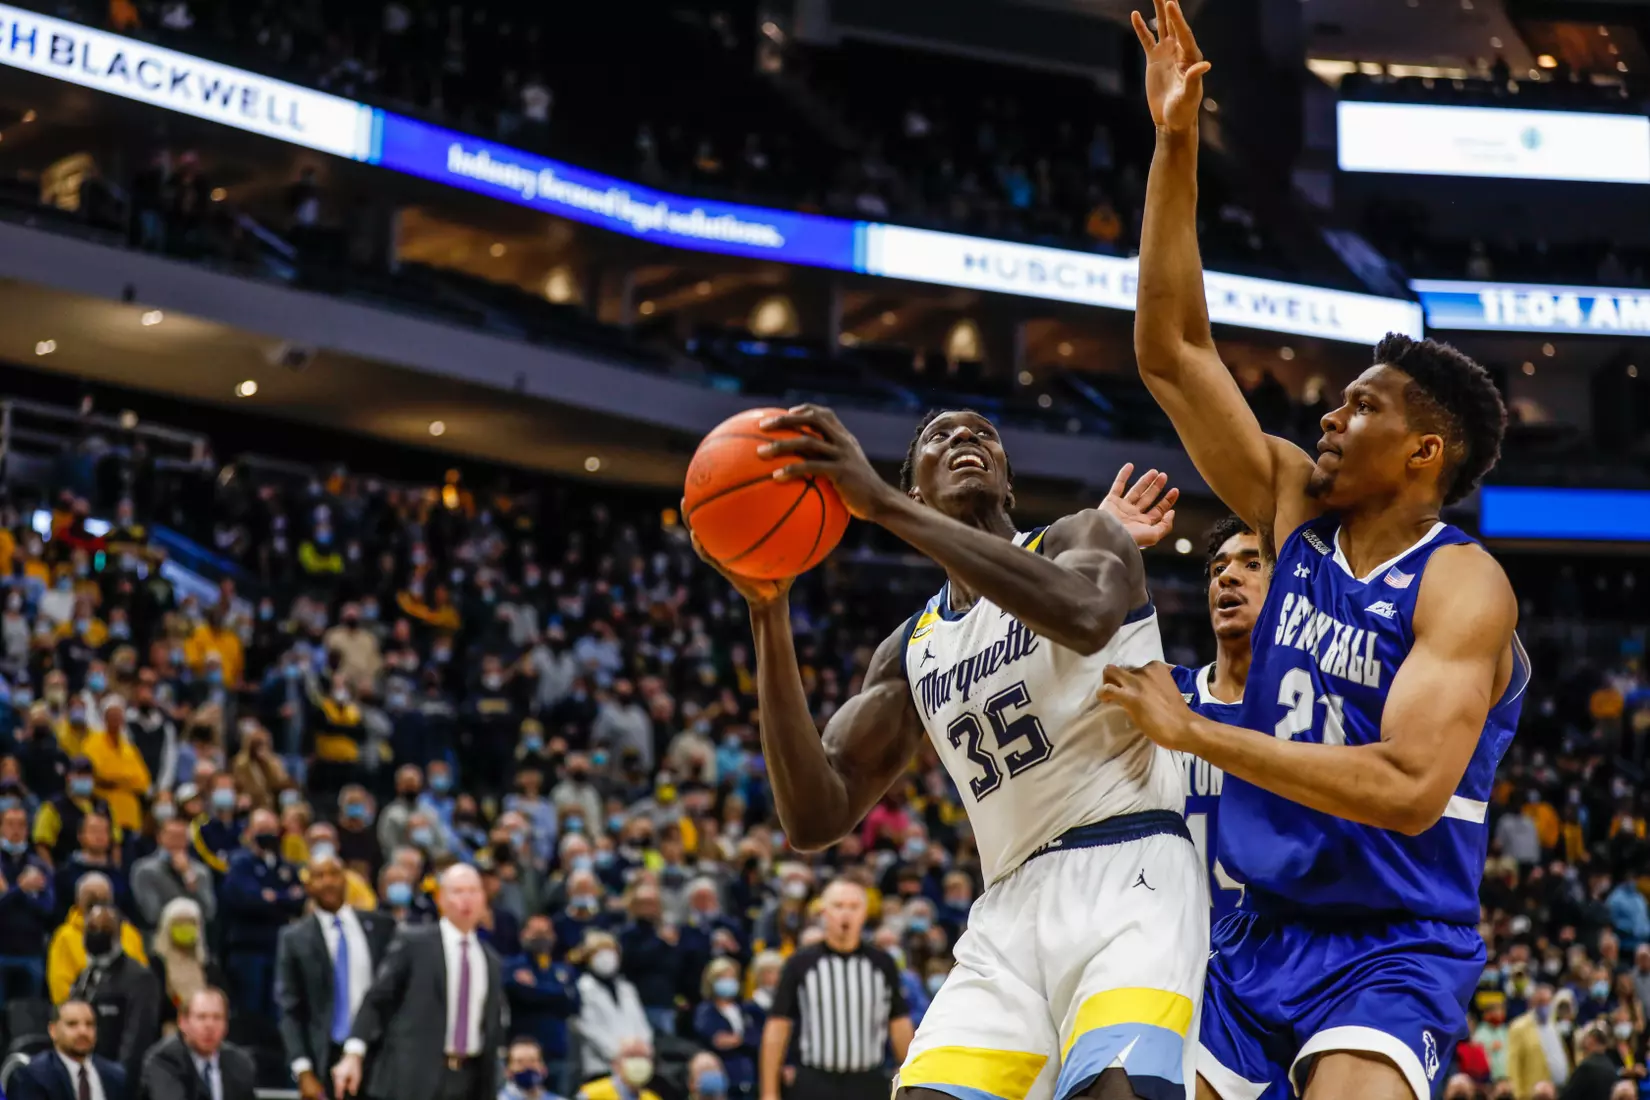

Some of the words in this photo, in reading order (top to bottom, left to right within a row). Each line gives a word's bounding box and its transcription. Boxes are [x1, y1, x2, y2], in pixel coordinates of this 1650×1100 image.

[49, 33, 307, 133] BLACKWELL
[963, 252, 1109, 290] HUSCH
[916, 616, 1039, 720] Marquette
[1319, 618, 1381, 689] HALL
[947, 680, 1054, 803] 35
[1275, 667, 1346, 745] 21
